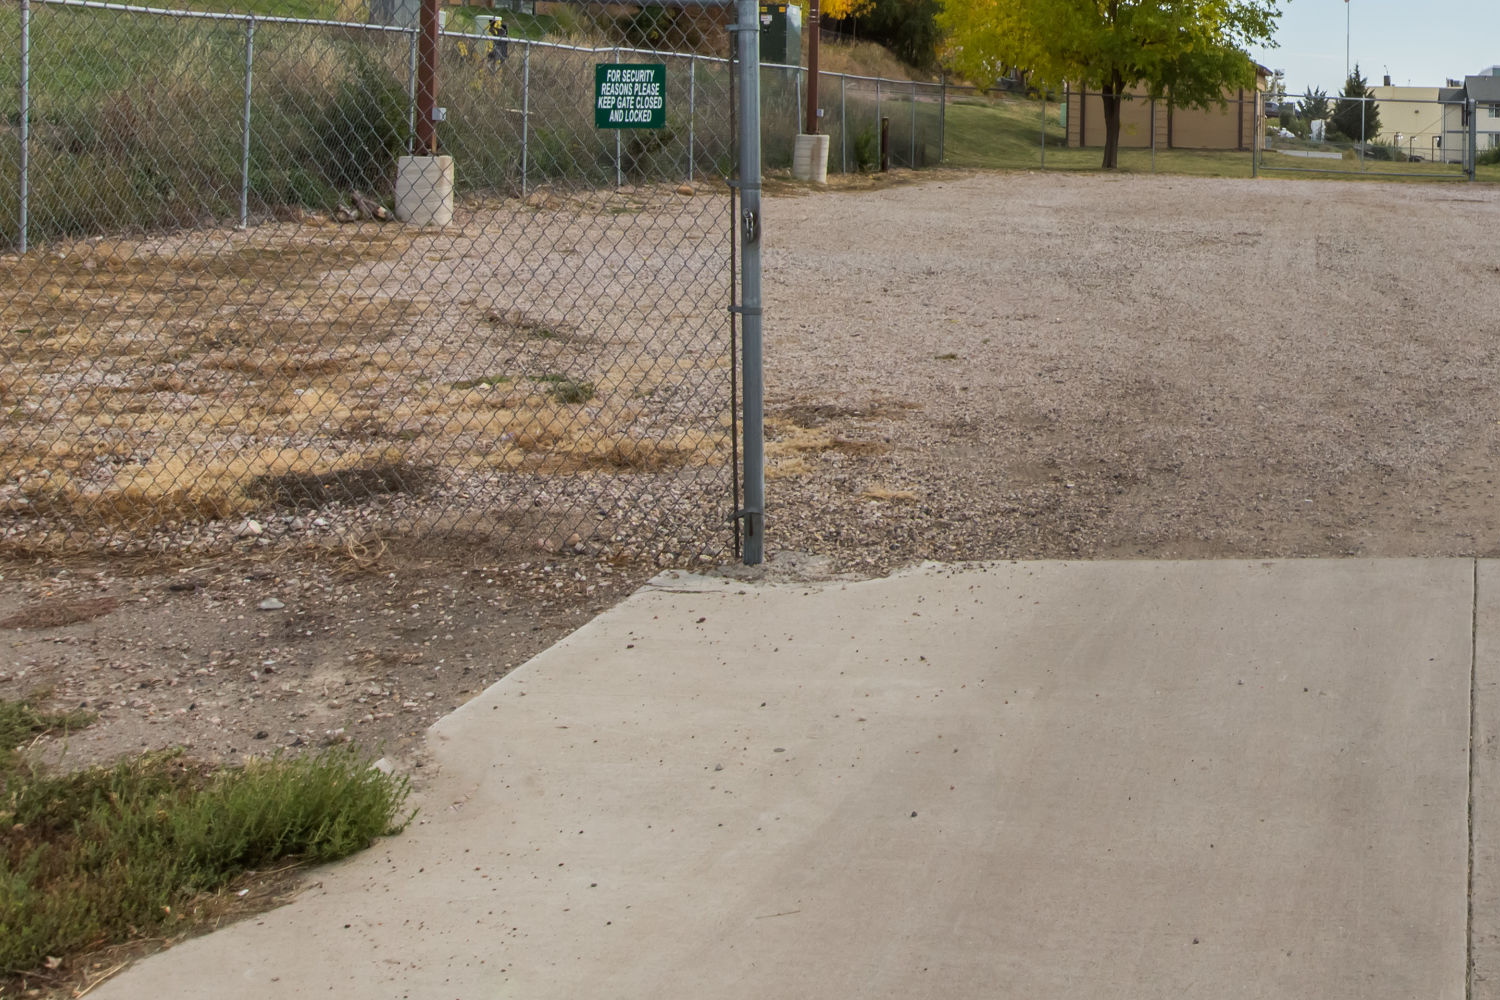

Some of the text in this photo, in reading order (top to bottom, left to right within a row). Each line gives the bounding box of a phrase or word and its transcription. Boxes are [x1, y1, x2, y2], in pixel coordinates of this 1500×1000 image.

[606, 69, 655, 82] FOR SECURITY
[601, 83, 660, 95] REASONS PLEASE
[598, 96, 663, 108] KEEP GATE CLOSED
[609, 109, 652, 122] AND LOCKED
